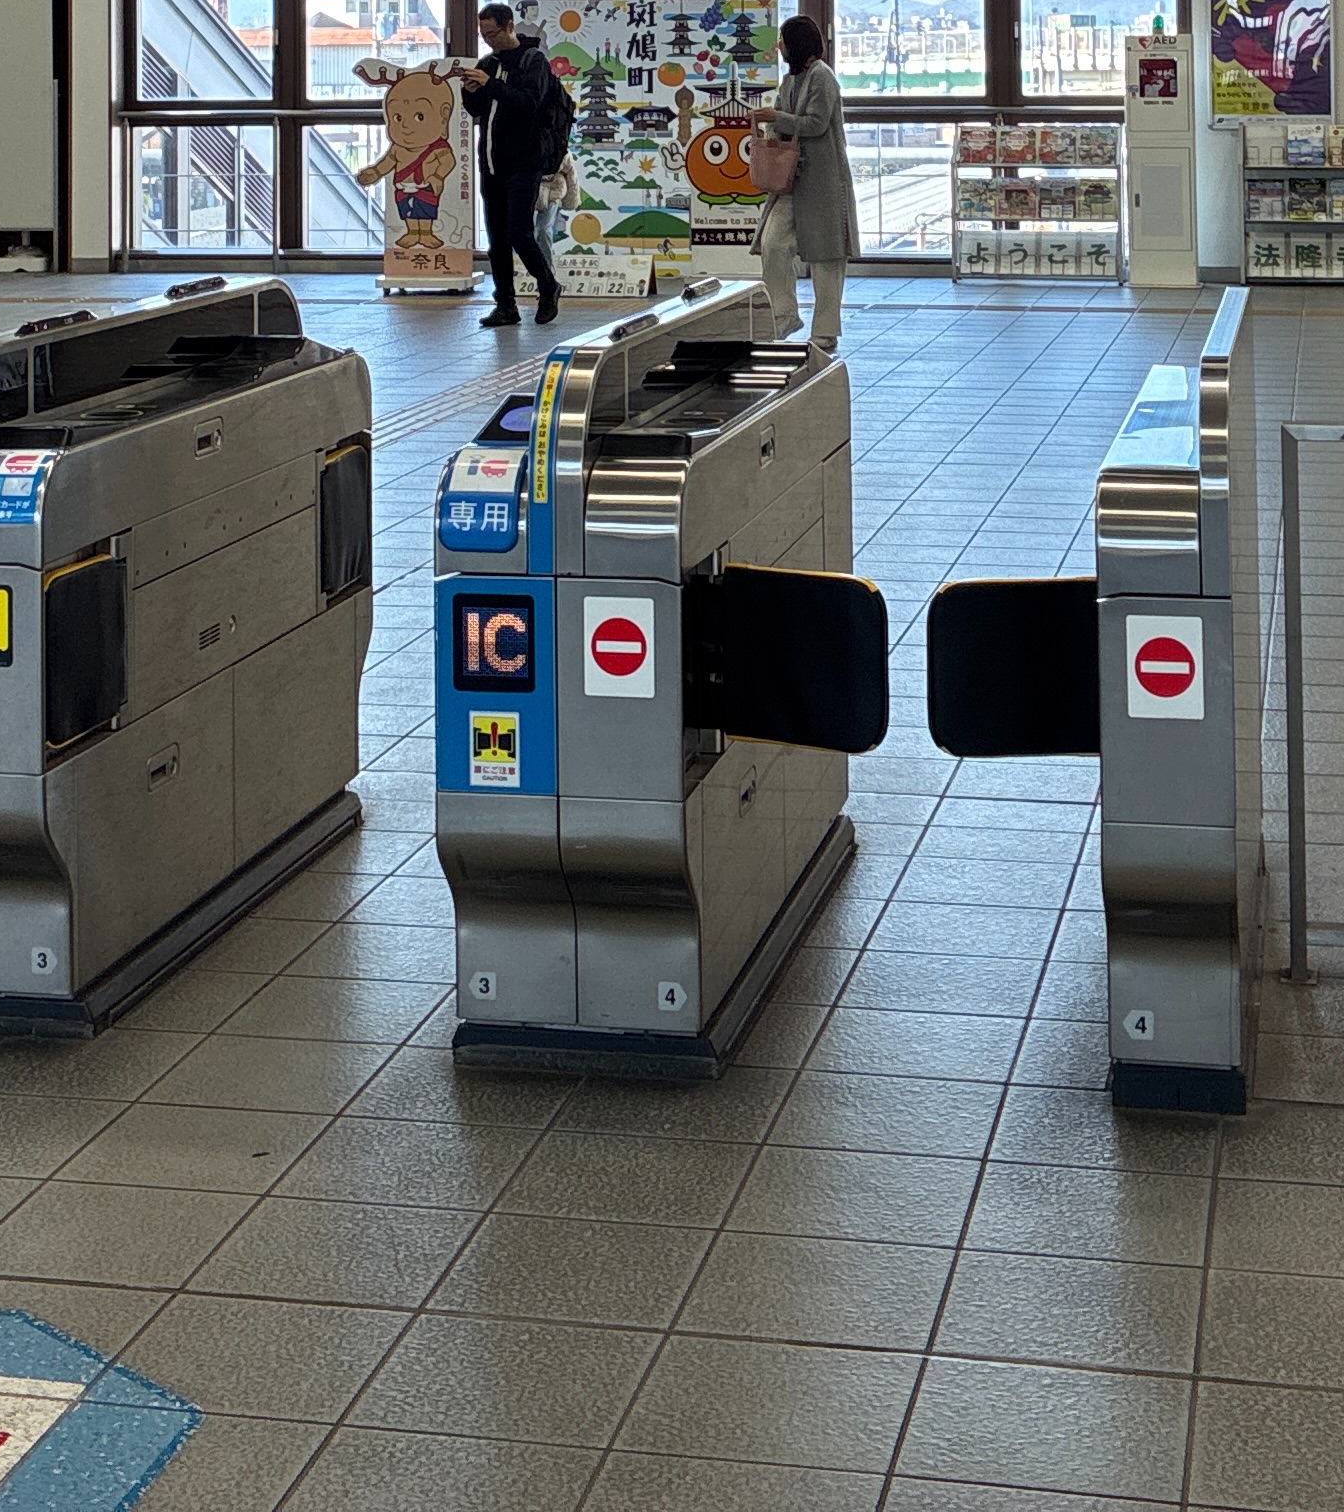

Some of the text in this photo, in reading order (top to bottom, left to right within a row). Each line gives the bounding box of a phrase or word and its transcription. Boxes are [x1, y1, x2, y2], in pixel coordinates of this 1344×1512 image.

[627, 0, 658, 95] 斑鳩町
[1153, 36, 1177, 45] AED
[694, 217, 741, 225] Welcome to
[411, 253, 451, 271] 奈良
[967, 242, 1110, 266] ようこそ
[576, 282, 585, 293] 2
[607, 282, 624, 293] 22
[447, 501, 509, 533] 専用
[467, 613, 526, 673] IC
[37, 952, 47, 969] 3
[479, 978, 490, 994] 3
[664, 987, 676, 1005] 4
[1134, 1017, 1147, 1034] 4
